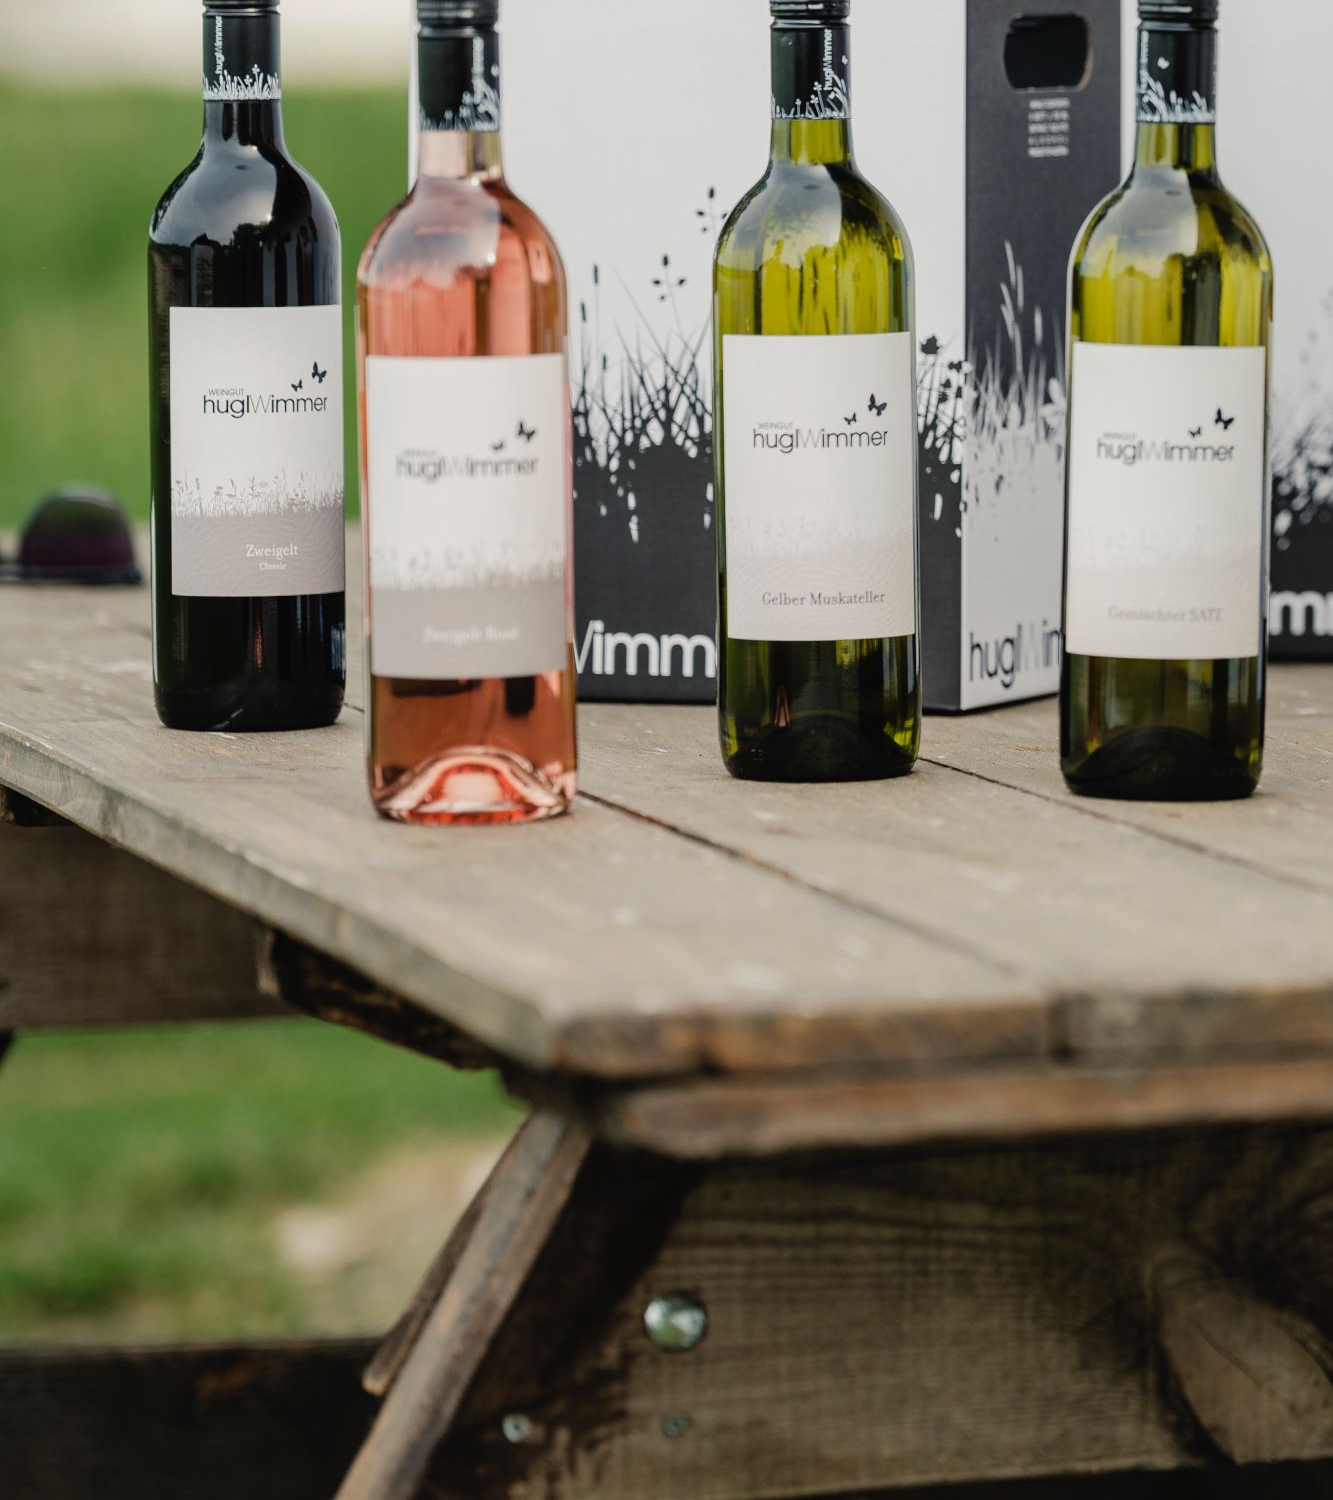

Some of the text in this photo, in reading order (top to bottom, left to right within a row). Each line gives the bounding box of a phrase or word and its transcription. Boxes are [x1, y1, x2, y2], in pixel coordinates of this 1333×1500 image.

[823, 28, 834, 91] huglWimmer
[208, 389, 245, 397] WEINGUT
[203, 394, 328, 419] huglWimmer
[758, 422, 793, 431] WEINGUT
[753, 428, 888, 454] huglWimmer
[1097, 438, 1234, 466] huglWimmer
[246, 542, 299, 561] Zweigelt
[259, 562, 288, 571] Classic
[762, 590, 885, 606] Gelber Muskateller
